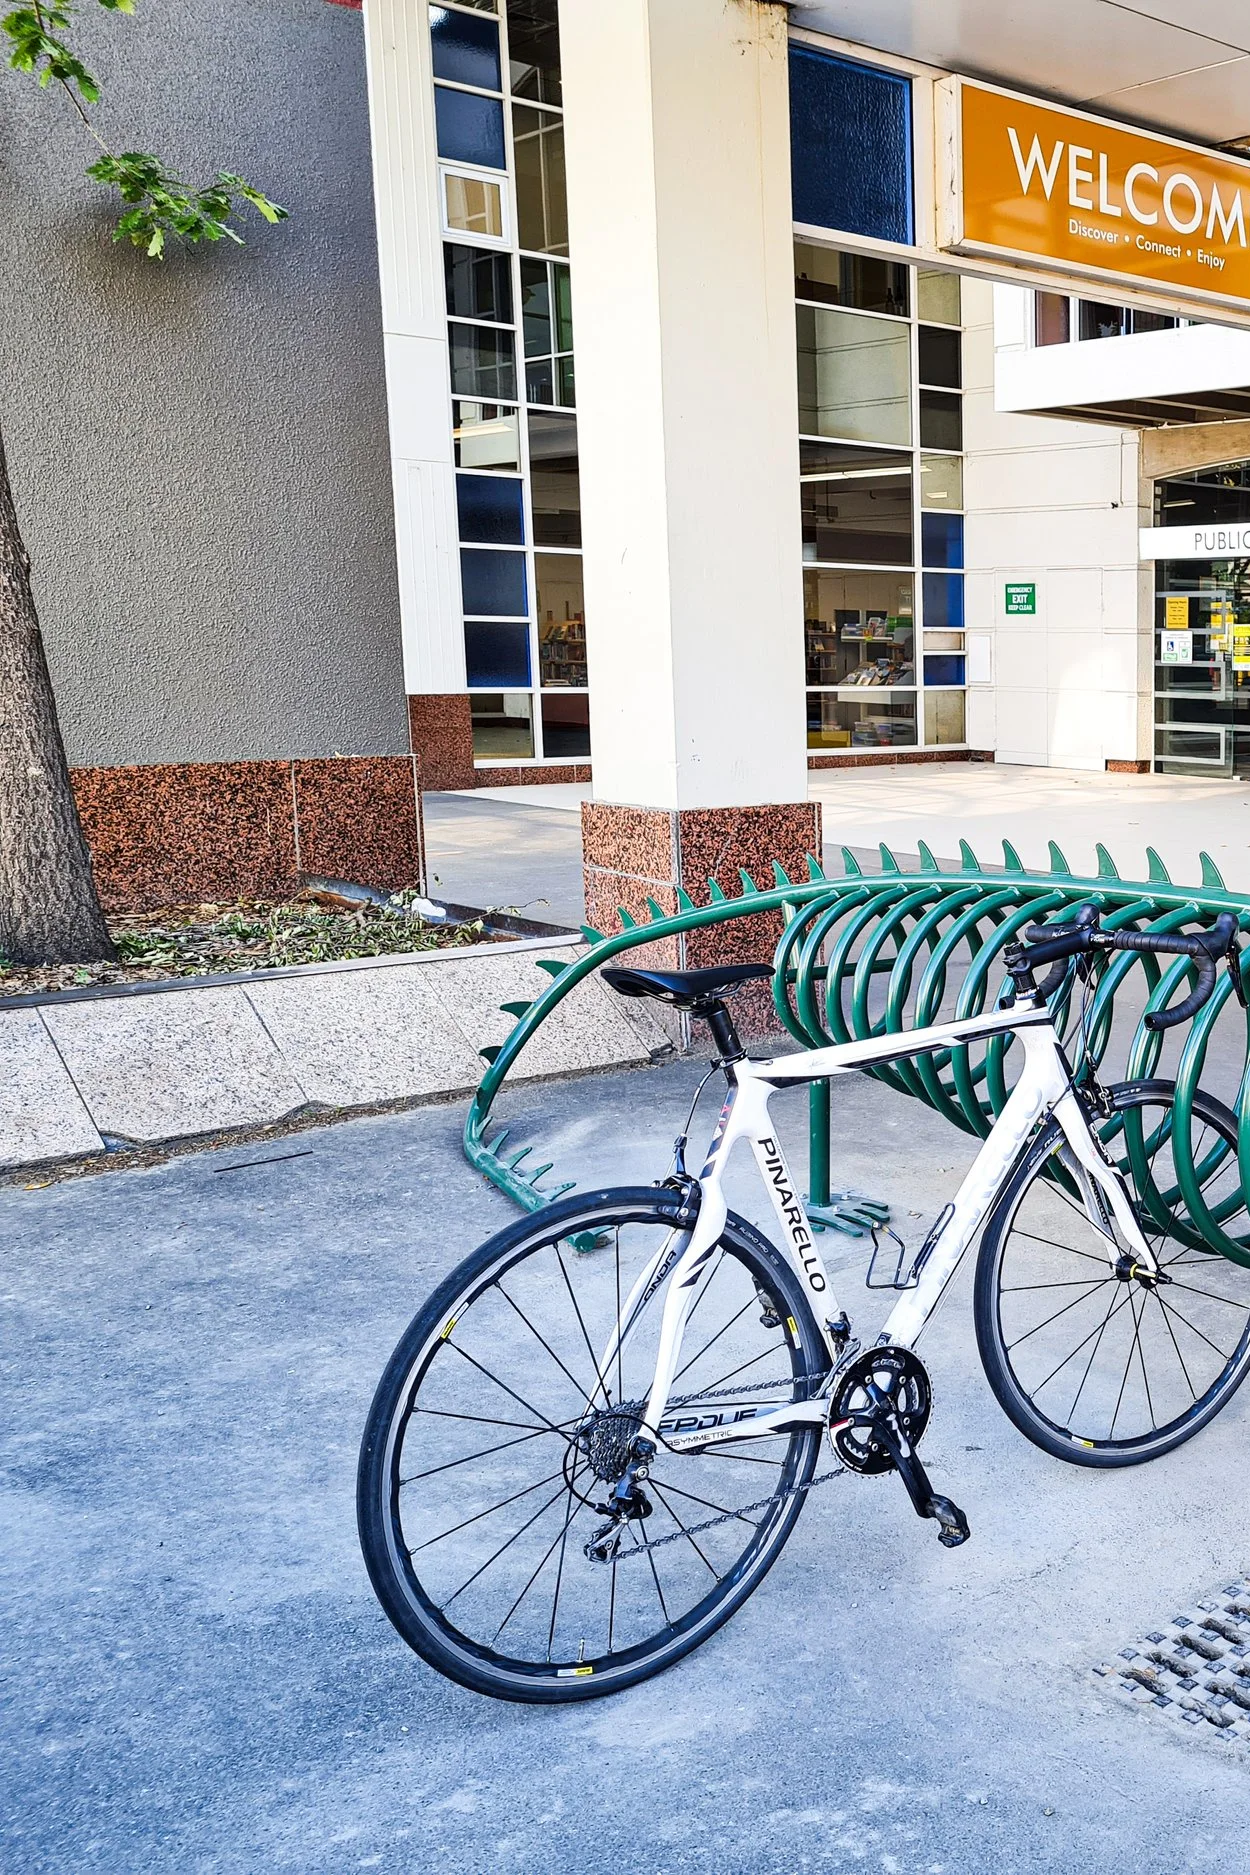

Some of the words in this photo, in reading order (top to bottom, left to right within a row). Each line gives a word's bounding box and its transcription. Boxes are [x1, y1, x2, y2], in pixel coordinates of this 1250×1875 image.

[1068, 218, 1119, 245] Discover
[1135, 233, 1182, 259] Connect
[1197, 248, 1226, 272] Enjoy
[1012, 594, 1029, 604] EXIT
[757, 1136, 826, 1293] PINARELLO
